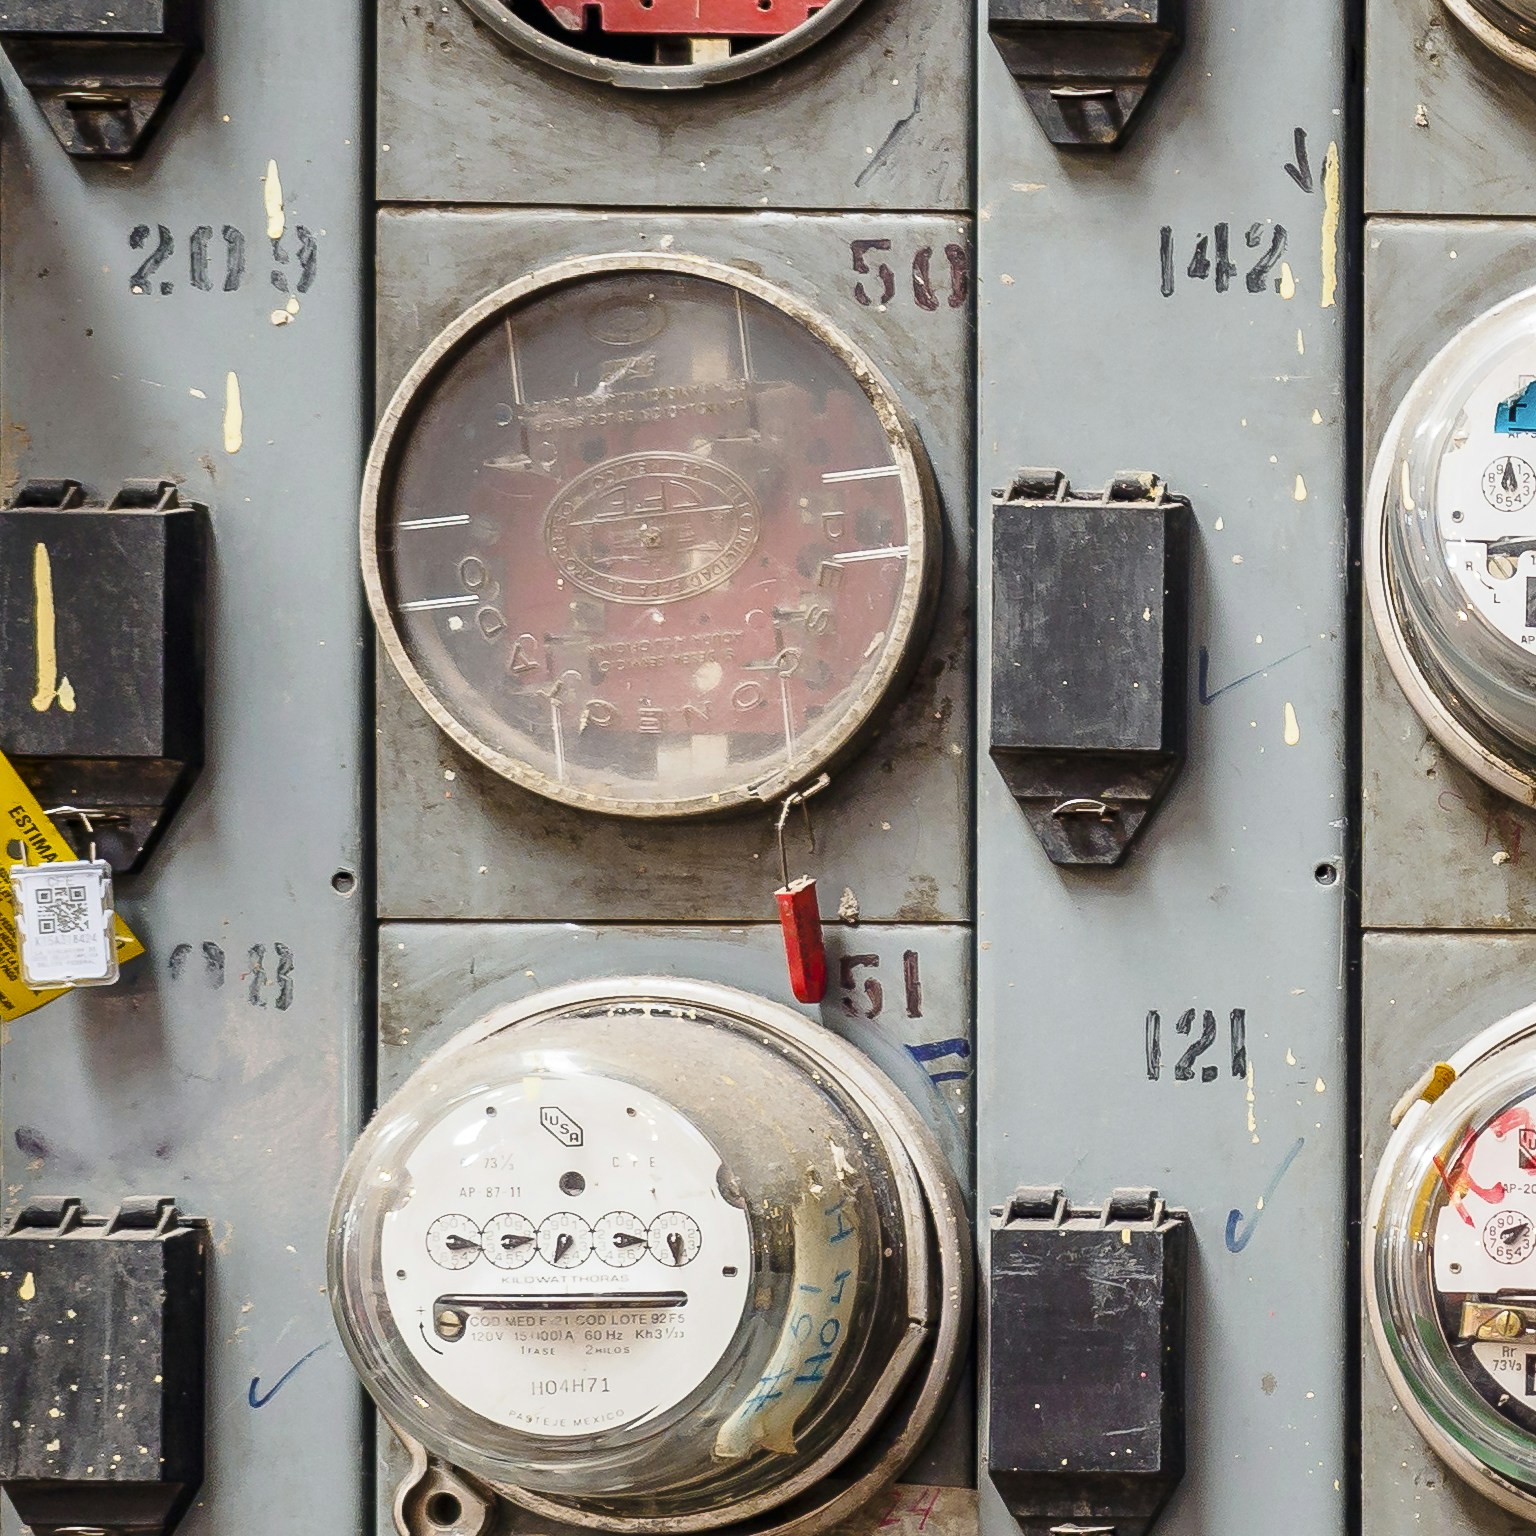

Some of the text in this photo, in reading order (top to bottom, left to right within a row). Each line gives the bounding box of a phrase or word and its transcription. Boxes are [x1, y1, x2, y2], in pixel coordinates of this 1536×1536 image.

[128, 223, 319, 295] 209
[849, 238, 970, 312] 50
[1160, 222, 1289, 298] 142
[7, 805, 59, 862] ESTIMA
[839, 949, 923, 1019] 51
[1145, 1008, 1246, 1082] 121
[543, 1111, 580, 1143] IUSA
[502, 1274, 630, 1284] KILOWATTHORAS
[531, 1377, 611, 1395] H04H71
